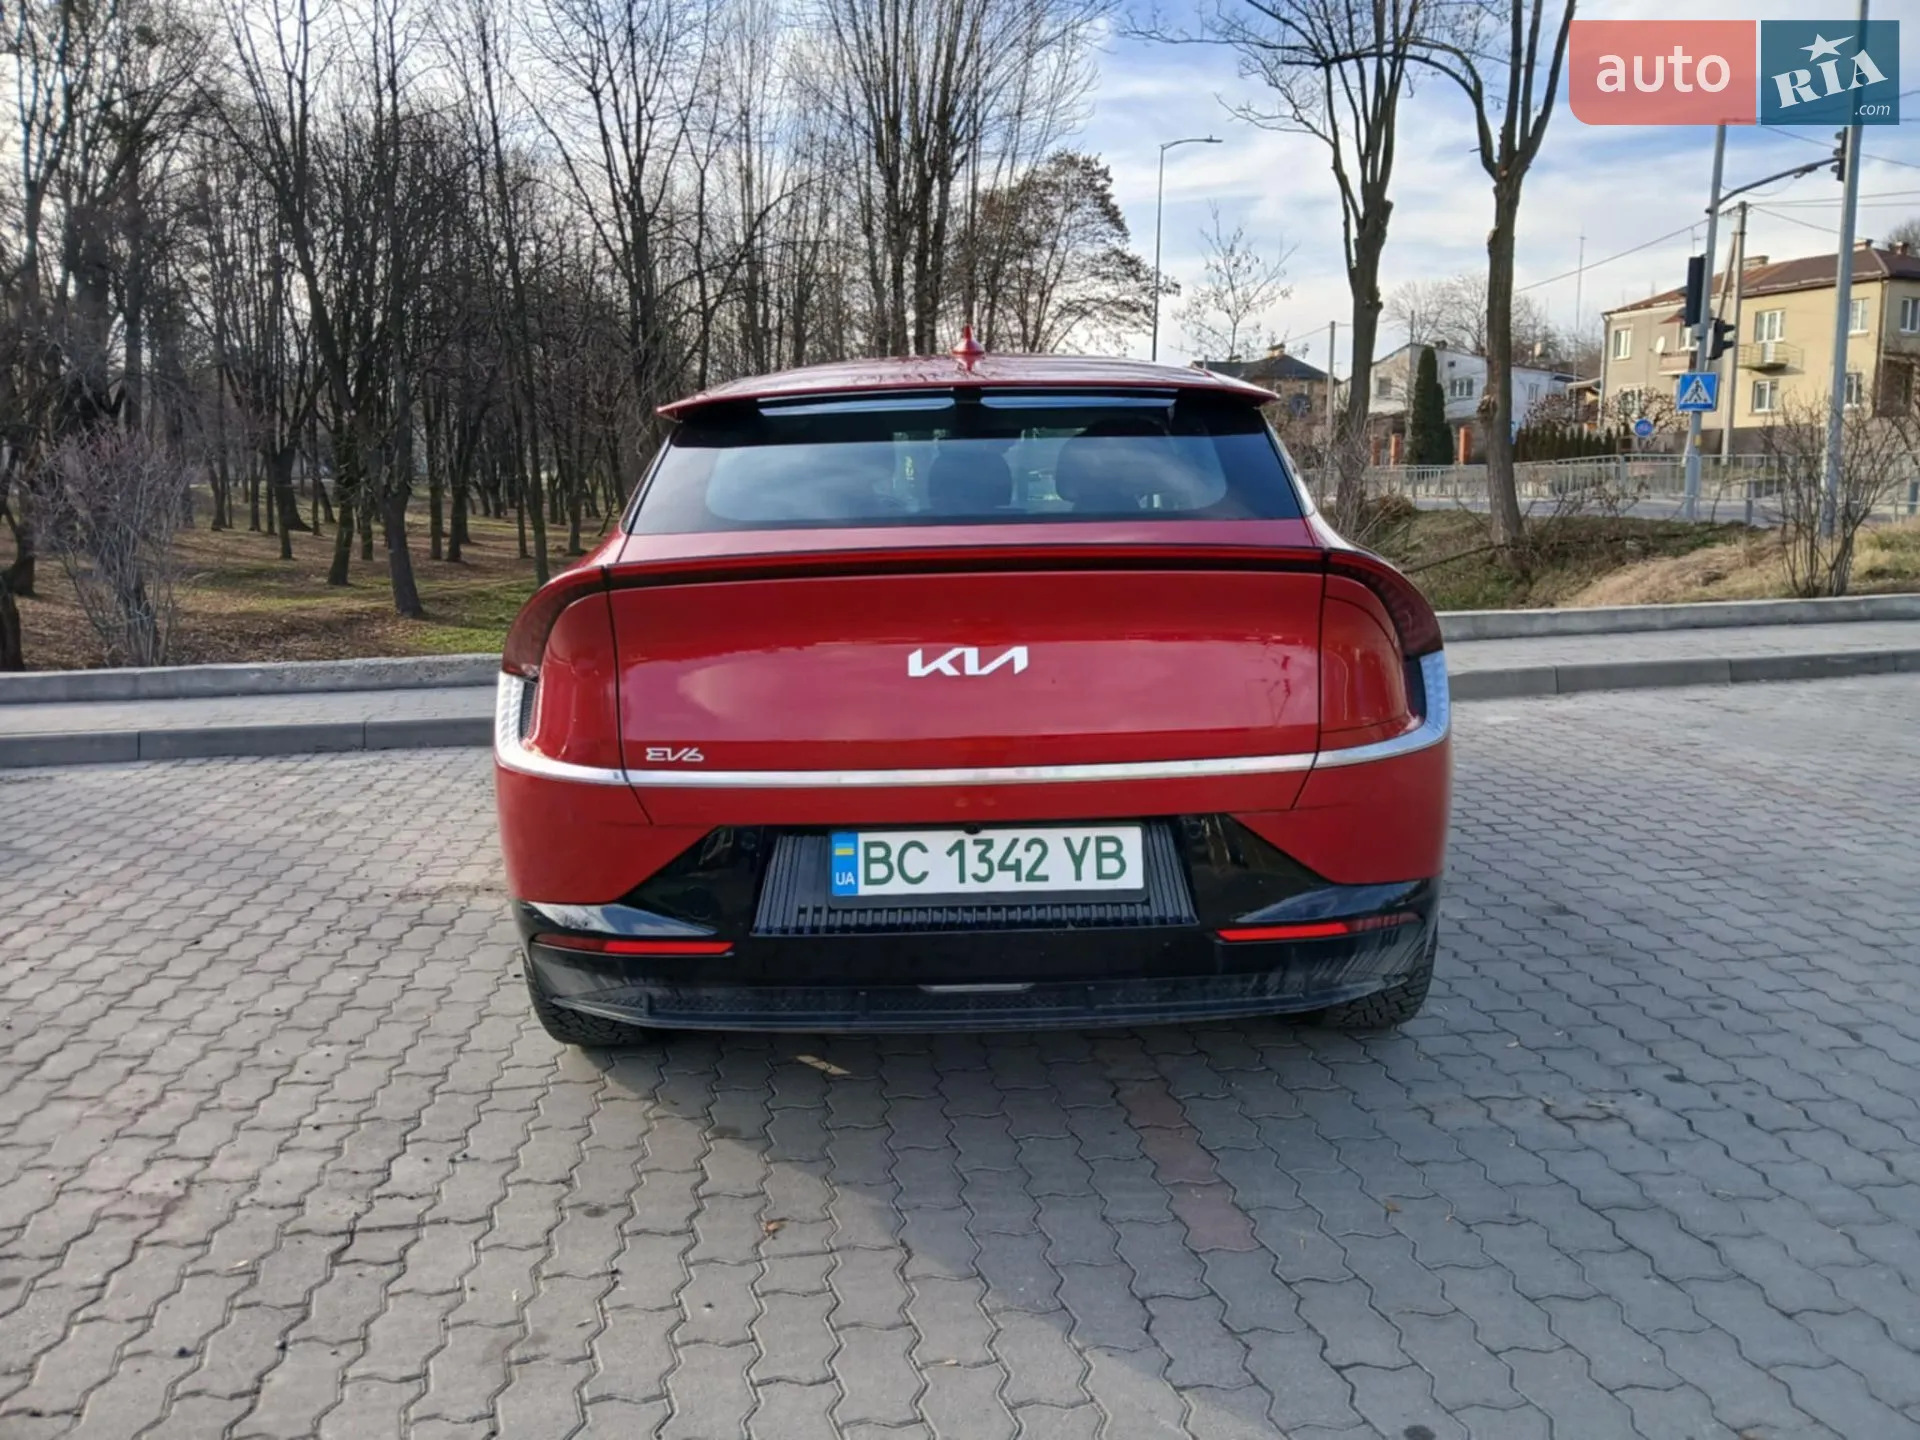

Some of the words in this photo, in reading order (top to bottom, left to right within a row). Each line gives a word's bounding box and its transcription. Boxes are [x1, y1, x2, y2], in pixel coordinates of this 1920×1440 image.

[646, 747, 704, 762] EV6
[863, 840, 929, 886] BC
[946, 837, 1049, 884] 1342
[1063, 835, 1127, 881] YB
[835, 871, 855, 886] UA
